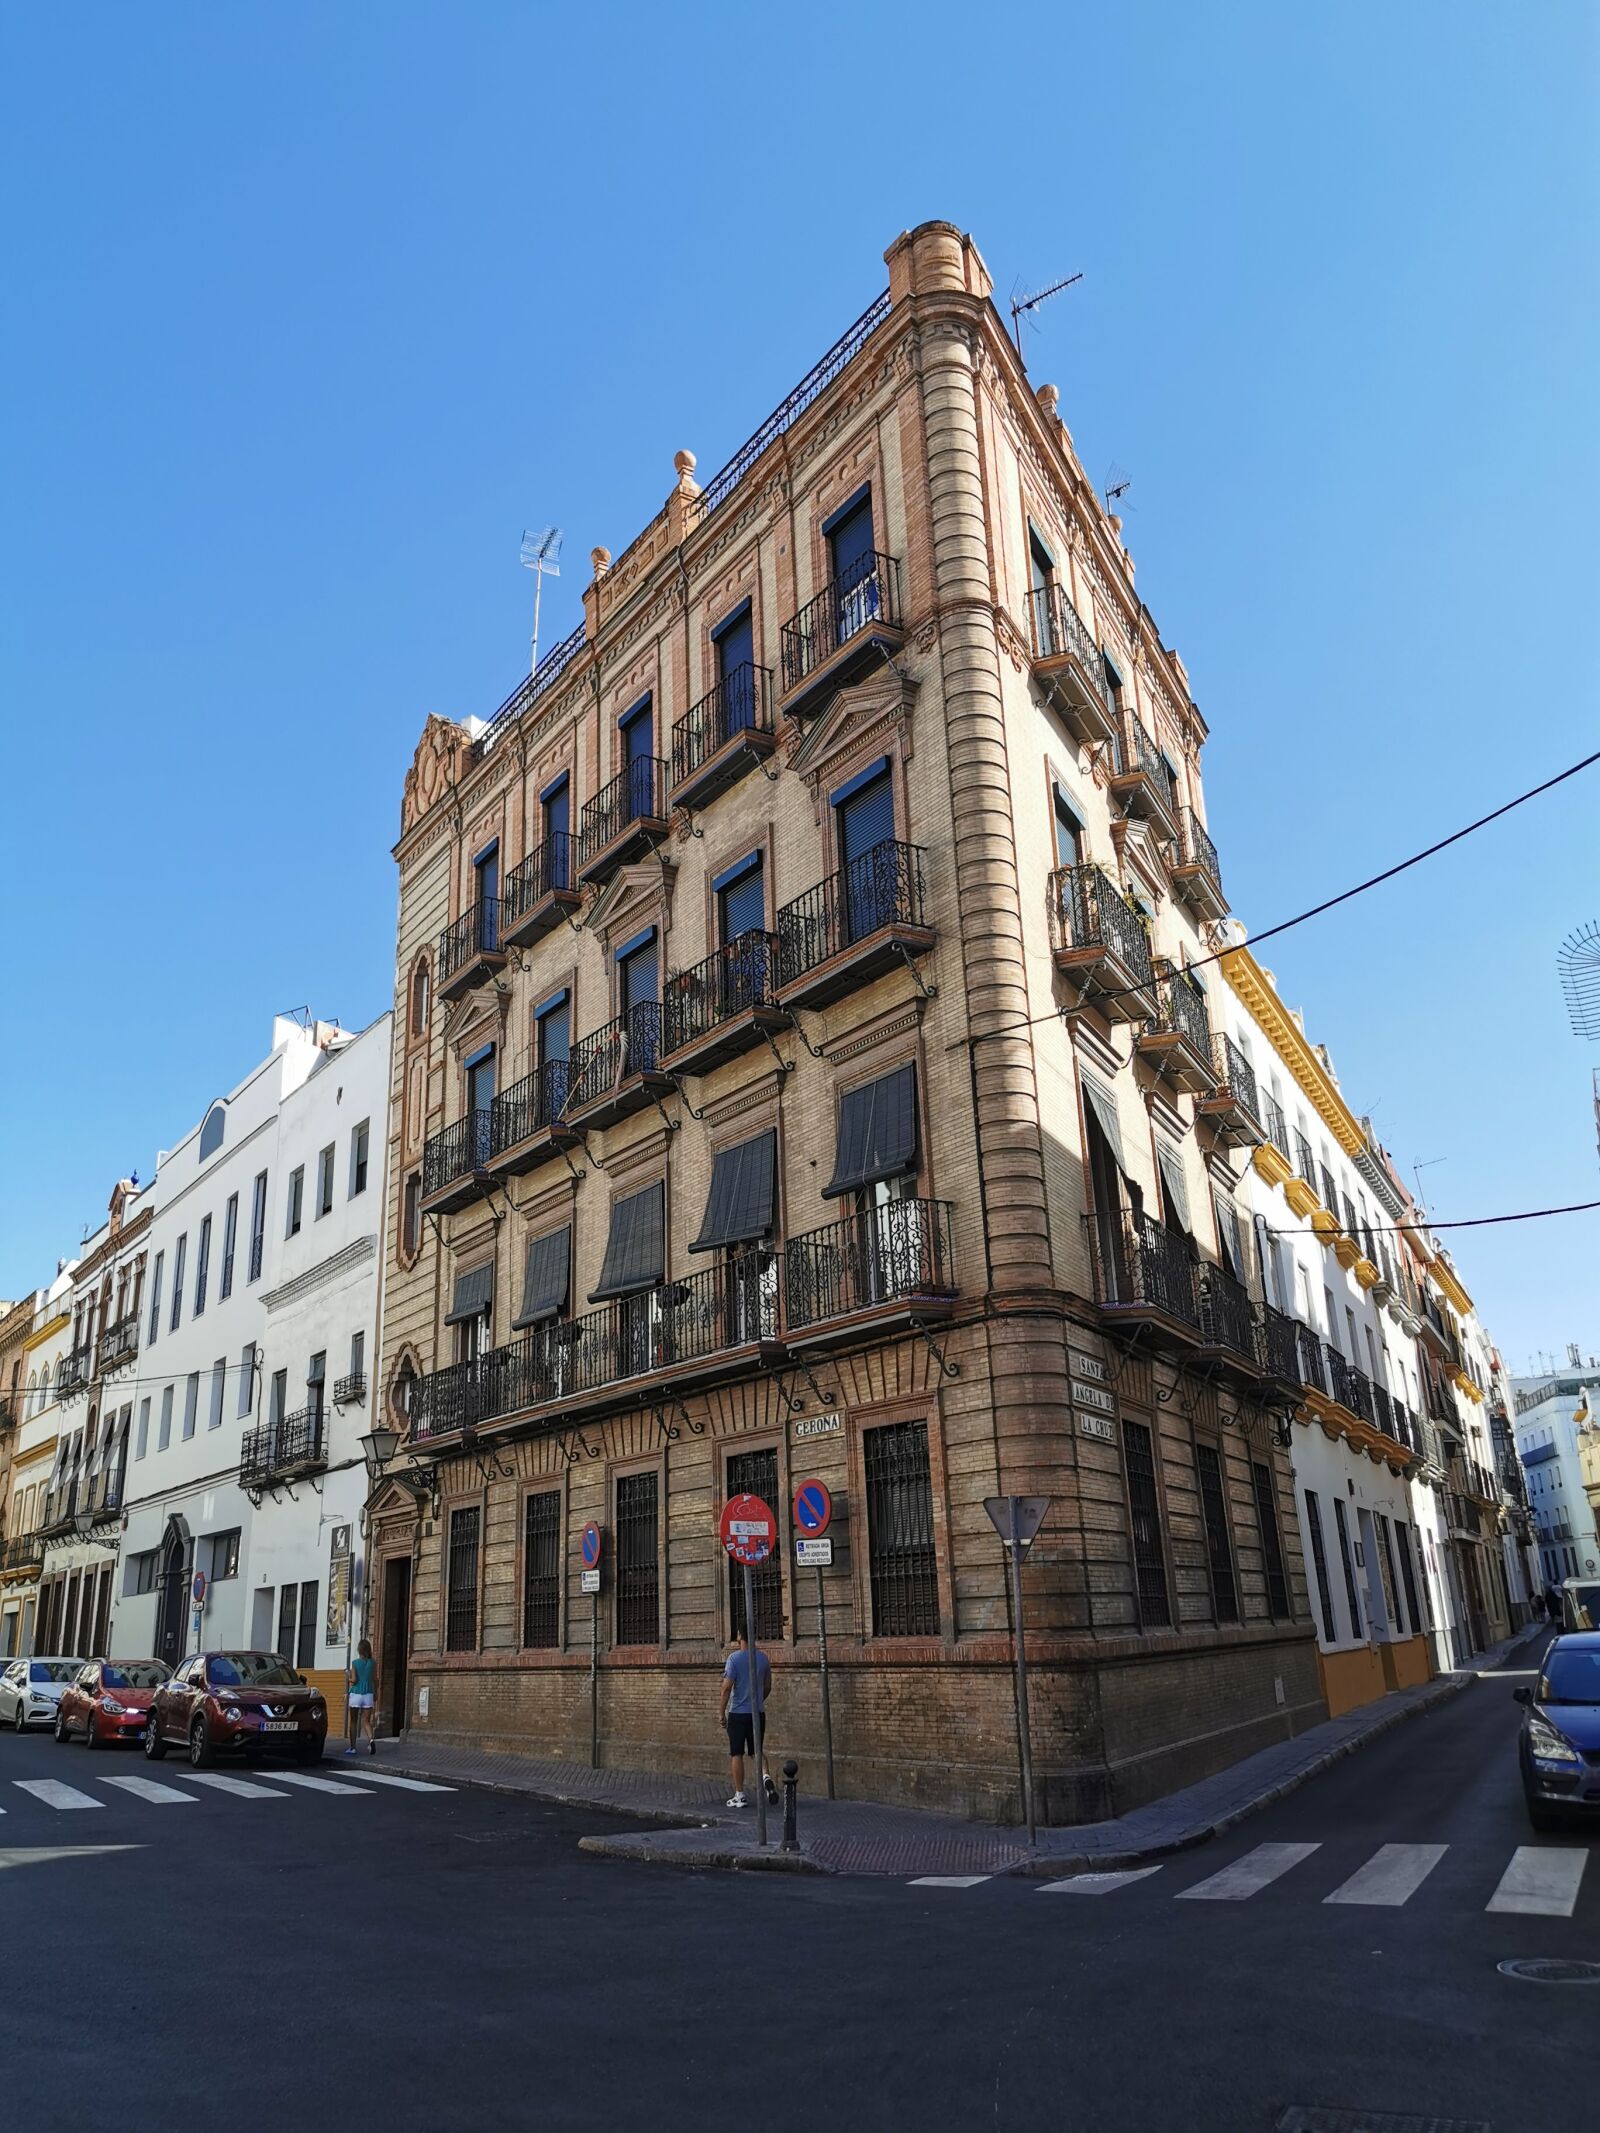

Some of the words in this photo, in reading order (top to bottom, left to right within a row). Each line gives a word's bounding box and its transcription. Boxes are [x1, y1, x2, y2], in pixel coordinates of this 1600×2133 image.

[1075, 1384, 1102, 1407] ANGELA
[796, 1415, 838, 1436] GERONA
[1082, 1415, 1092, 1432] LA
[1095, 1420, 1113, 1438] CRUZ
